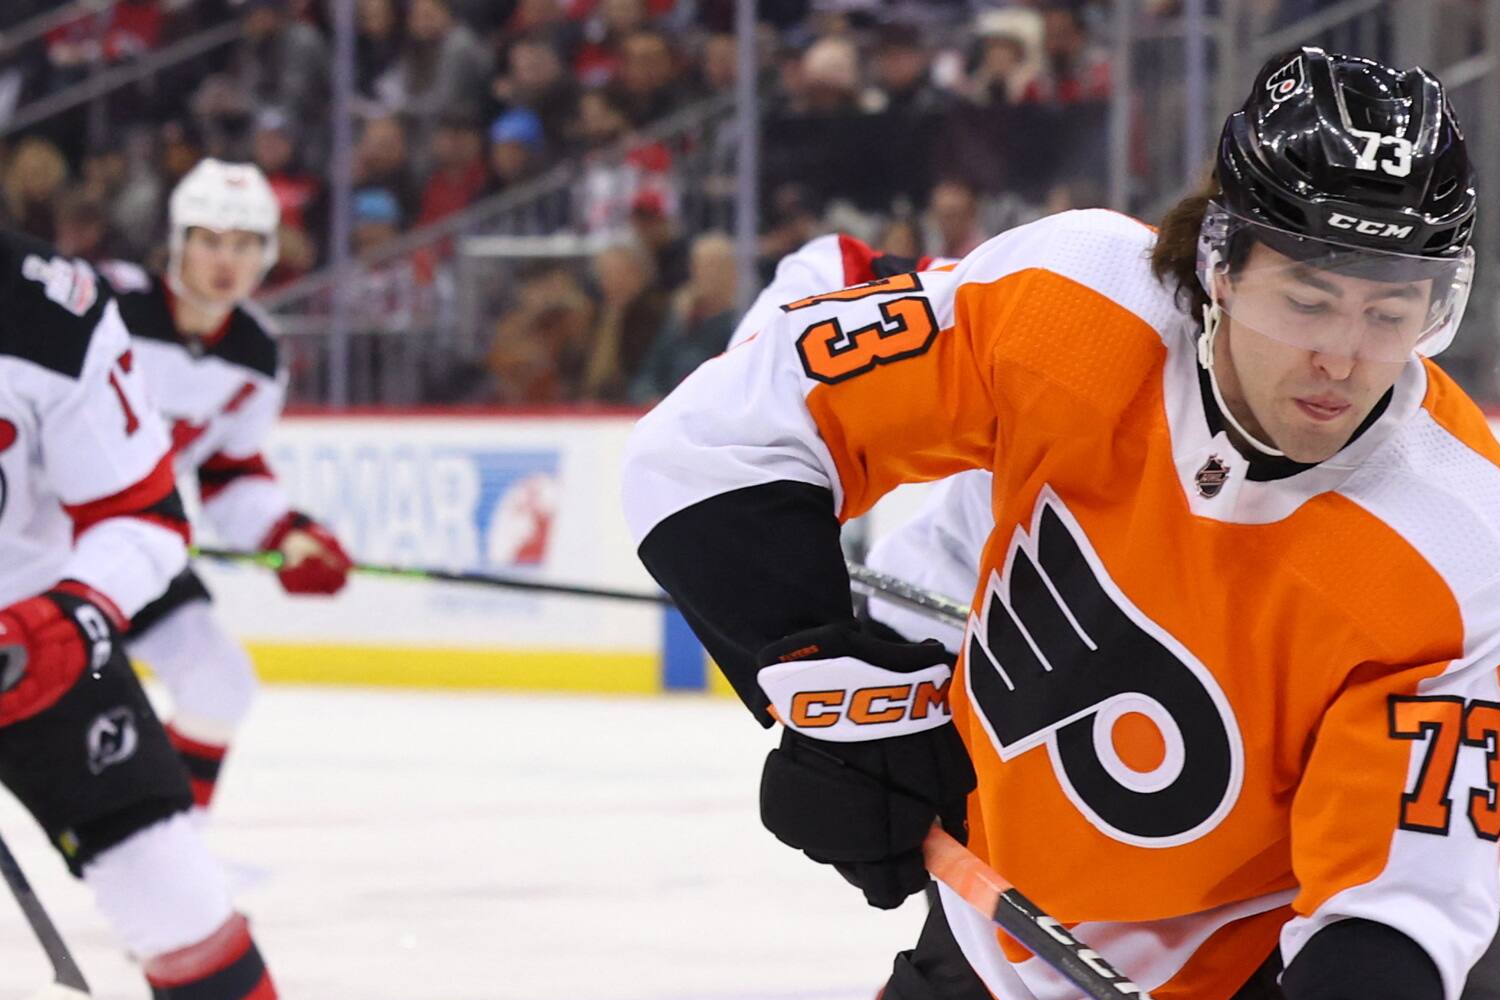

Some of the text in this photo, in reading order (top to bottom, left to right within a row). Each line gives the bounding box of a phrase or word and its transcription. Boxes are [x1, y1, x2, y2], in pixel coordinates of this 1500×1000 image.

[1350, 129, 1412, 177] 73
[1327, 213, 1415, 239] CCM
[790, 677, 951, 728] CCM
